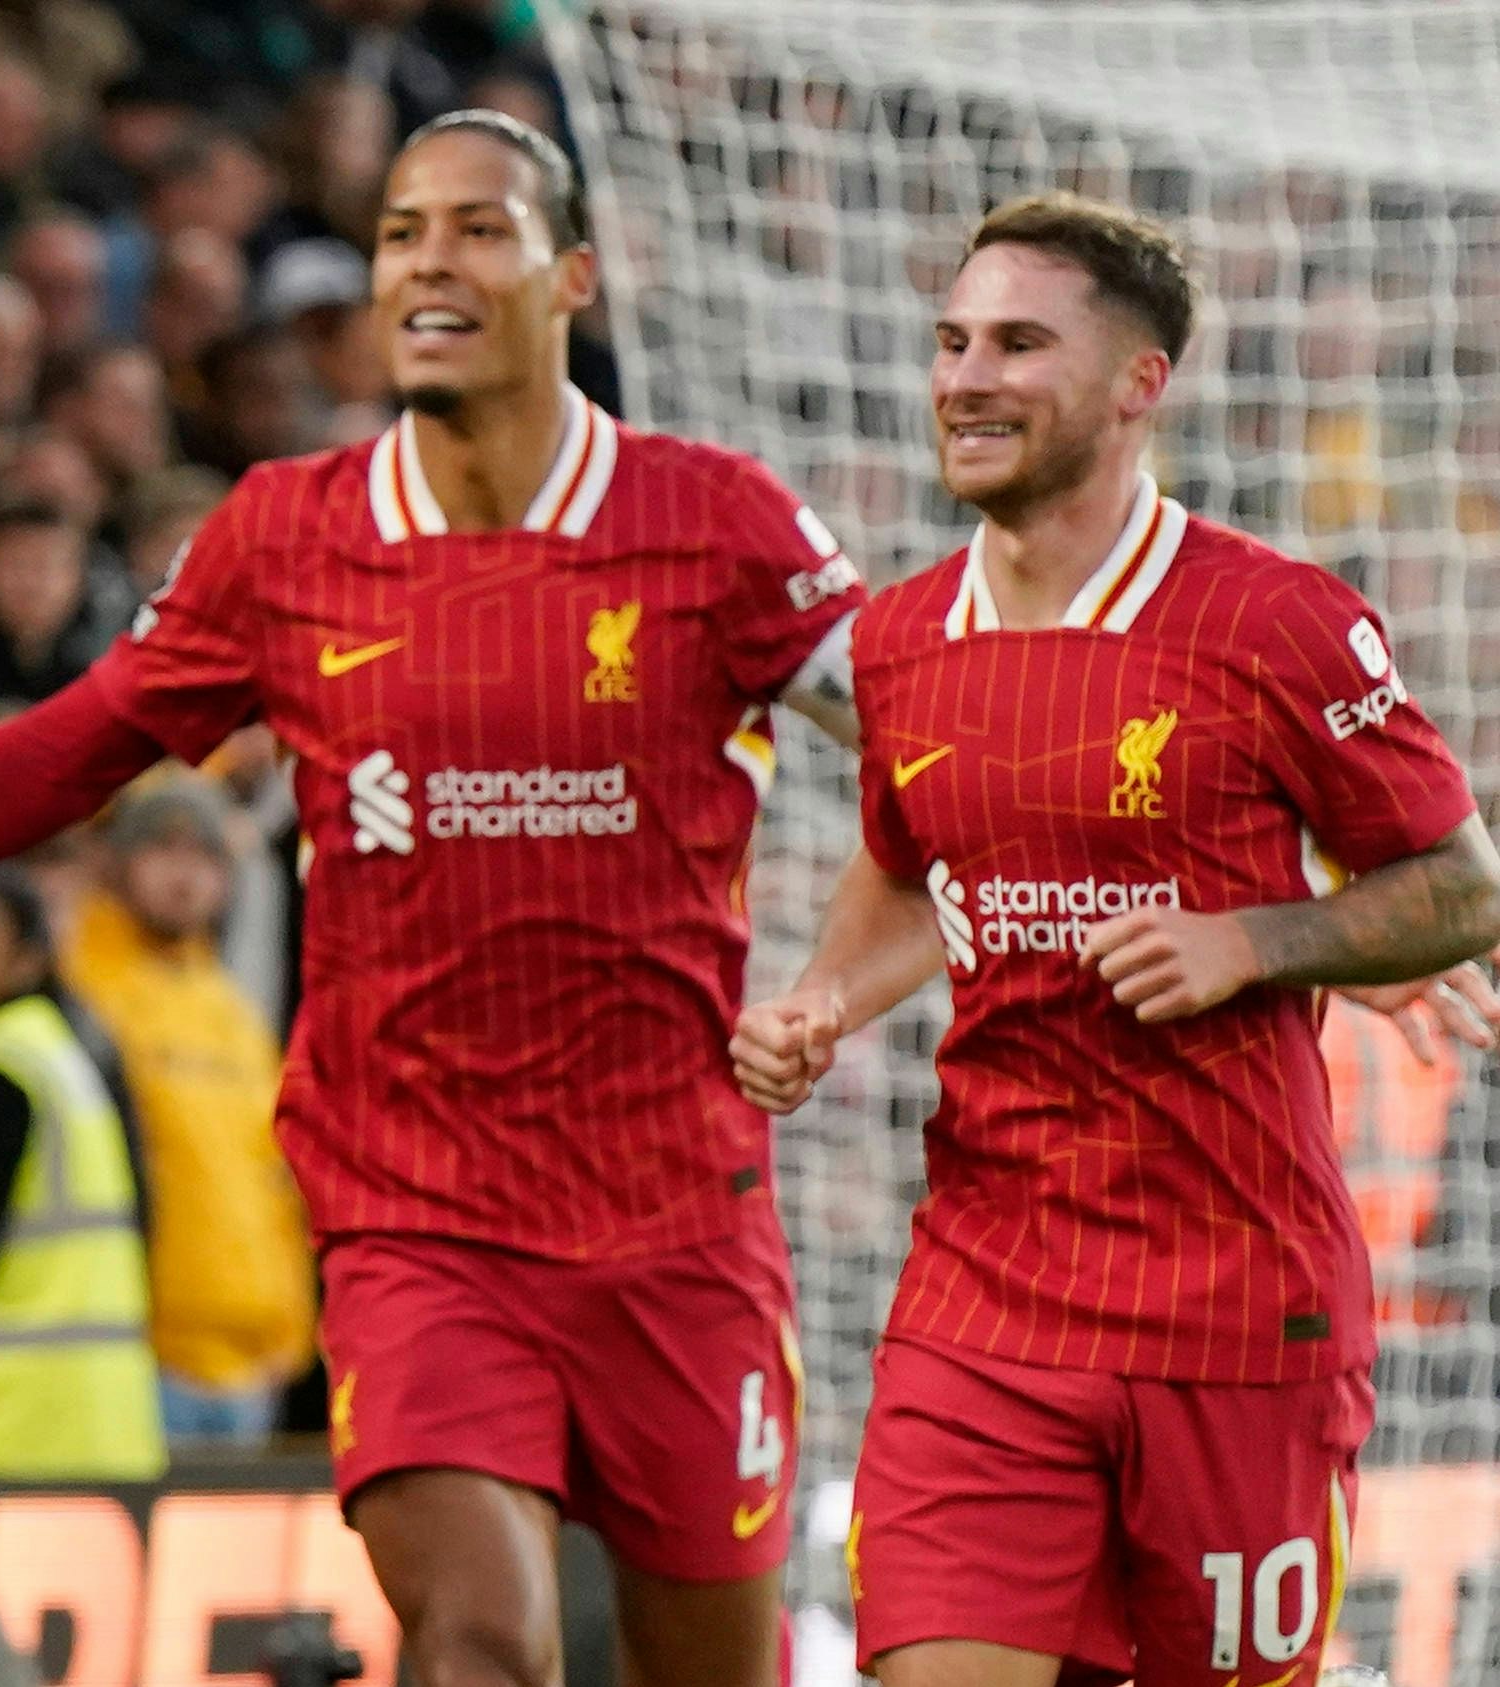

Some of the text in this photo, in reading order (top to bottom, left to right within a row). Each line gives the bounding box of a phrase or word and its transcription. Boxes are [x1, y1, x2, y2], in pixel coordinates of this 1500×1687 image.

[425, 763, 626, 804] standard
[426, 796, 638, 839] chartered
[976, 873, 1181, 916] standard
[979, 912, 1090, 955] chart
[737, 1370, 785, 1486] 4
[1202, 1537, 1318, 1670] 10
